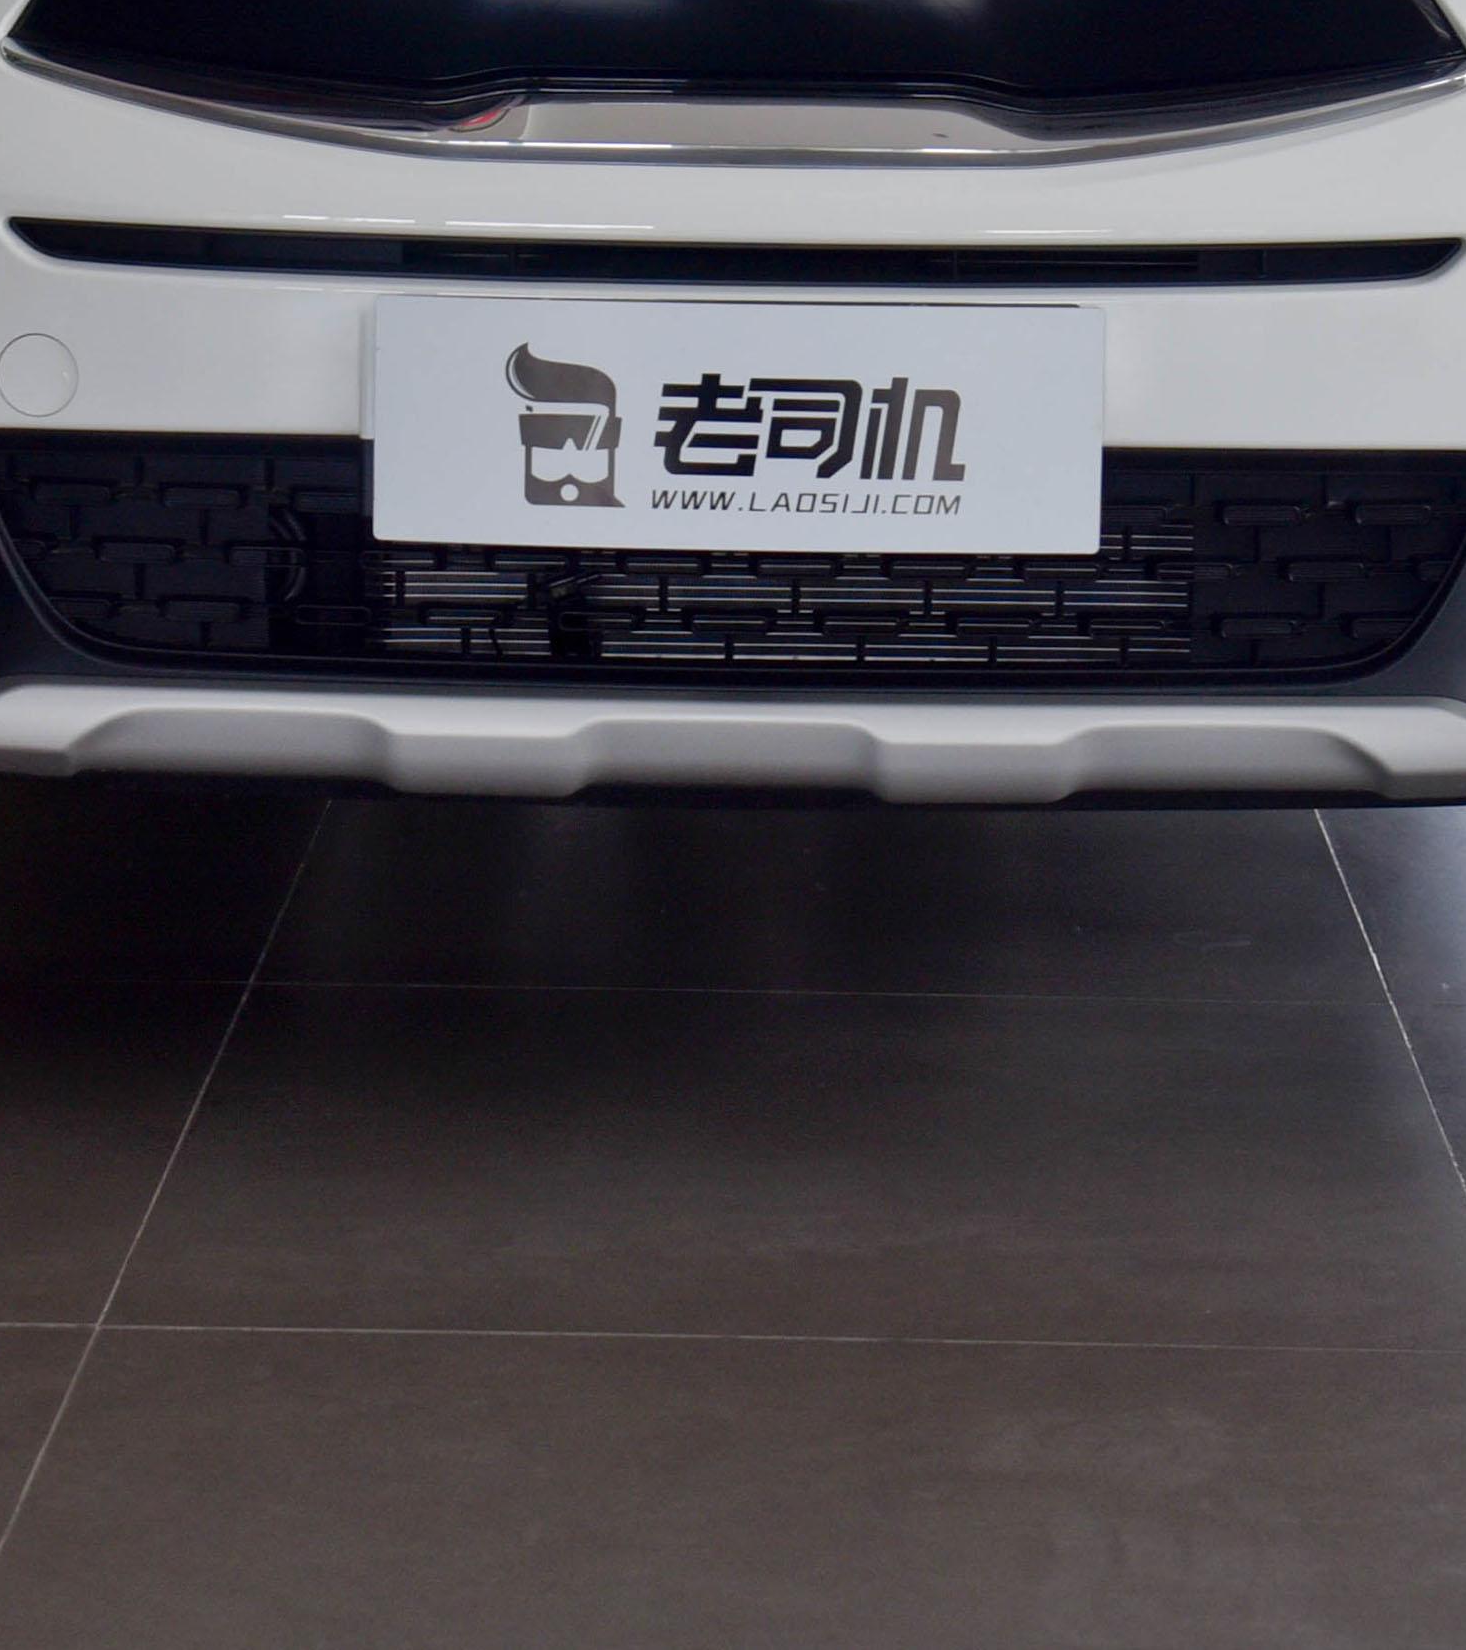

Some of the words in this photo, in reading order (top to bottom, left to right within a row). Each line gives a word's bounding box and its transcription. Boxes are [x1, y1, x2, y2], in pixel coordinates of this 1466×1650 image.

[654, 373, 966, 481] 老司机
[651, 489, 962, 516] WWW.LAOSIJI.COM
